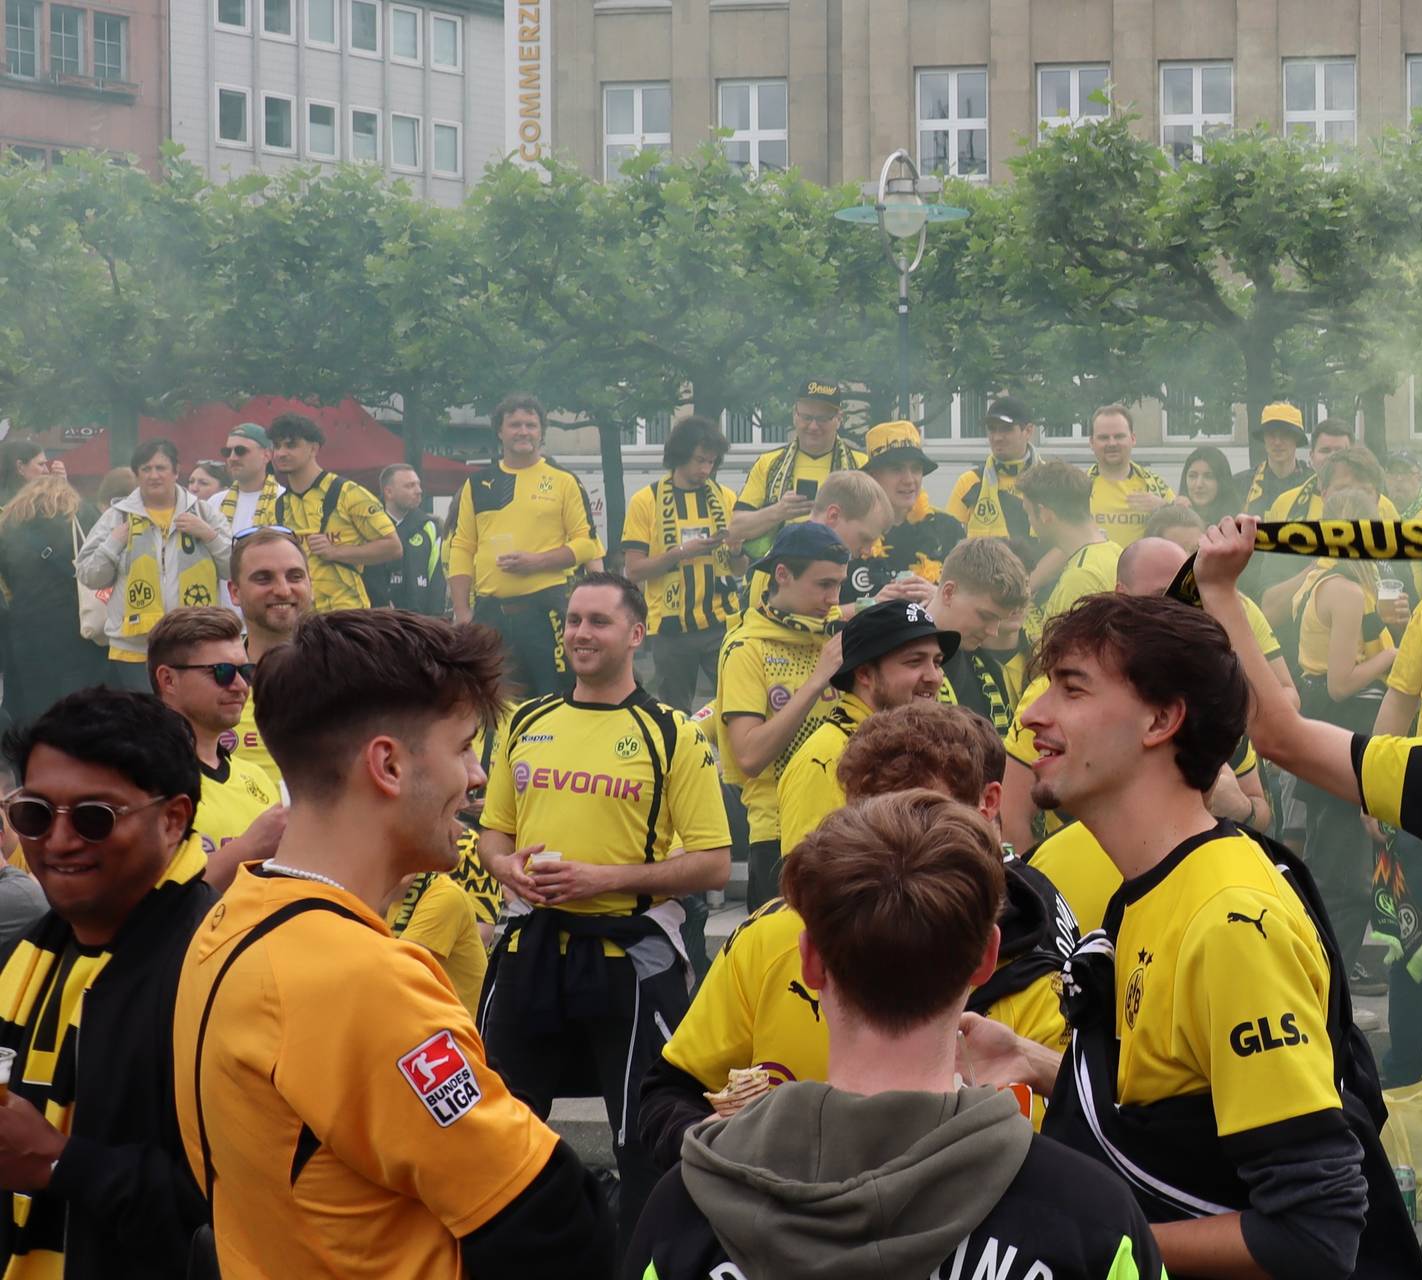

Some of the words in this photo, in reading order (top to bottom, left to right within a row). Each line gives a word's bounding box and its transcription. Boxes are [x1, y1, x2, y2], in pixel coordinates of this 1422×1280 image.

[518, 0, 541, 161] COMMERZ
[1096, 513, 1147, 525] EVONI
[129, 582, 150, 603] BVB
[521, 735, 554, 743] Kappa
[617, 737, 638, 752] BVB
[532, 768, 643, 801] EVONIK
[1230, 1012, 1309, 1057] GLS.
[425, 1068, 471, 1107] BUNDES
[432, 1081, 480, 1124] LIGA
